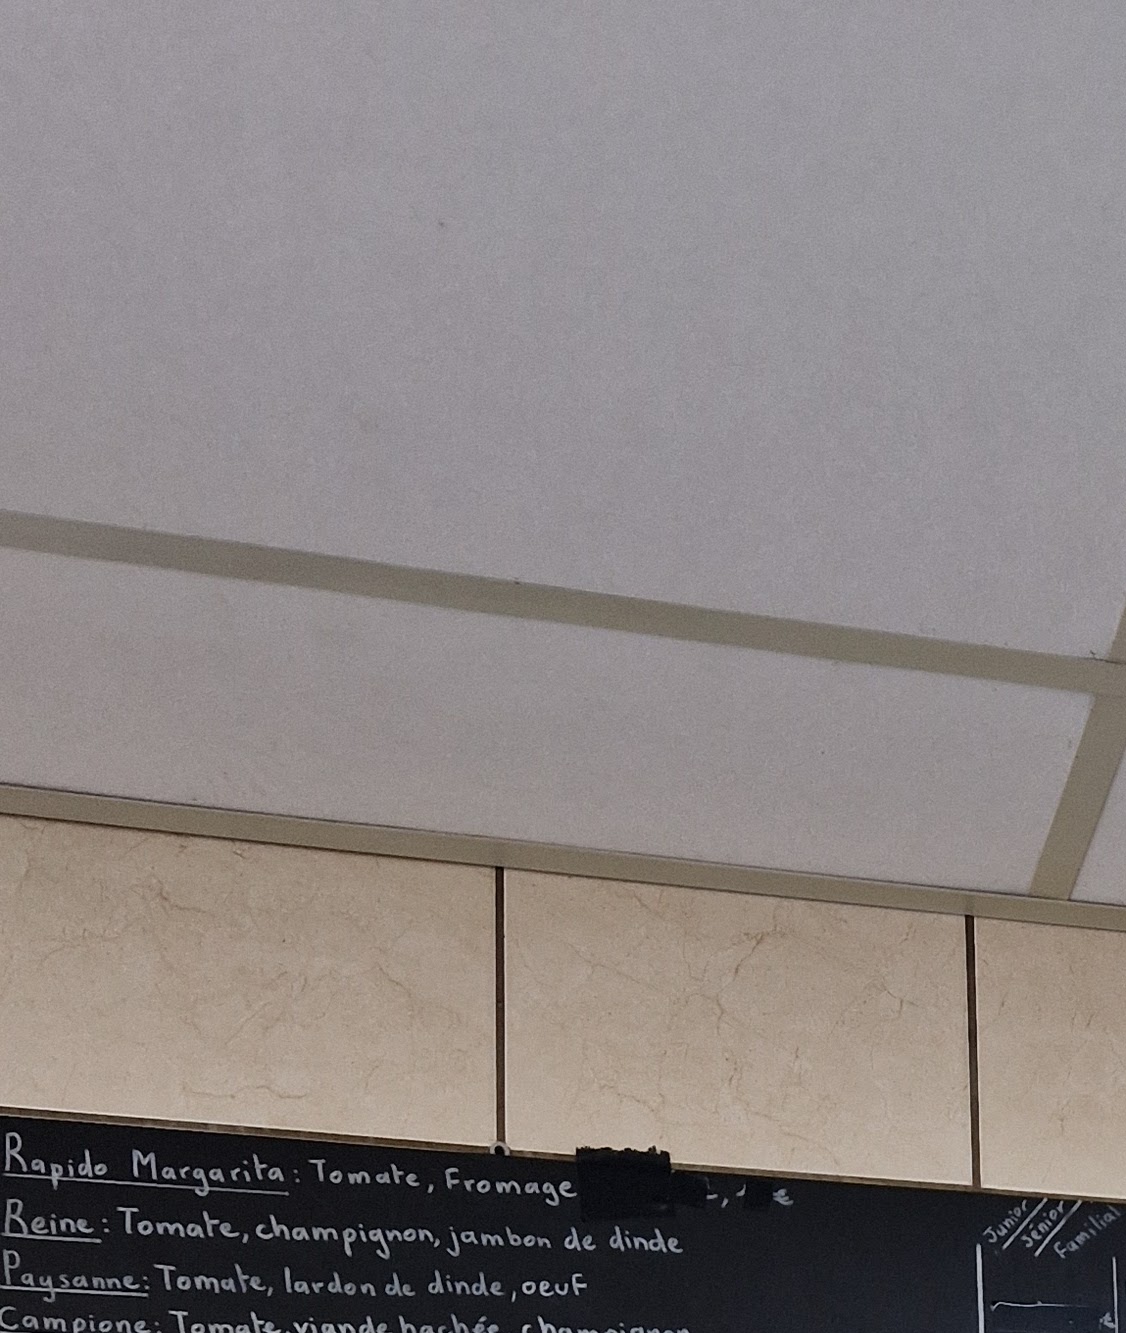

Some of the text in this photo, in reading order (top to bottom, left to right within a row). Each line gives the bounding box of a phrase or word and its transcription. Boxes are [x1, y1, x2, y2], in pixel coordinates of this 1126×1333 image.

[5, 1133, 109, 1193] Rapido
[446, 1224, 552, 1254] jambon
[564, 1228, 596, 1251] de
[609, 1228, 684, 1254] dinde
[284, 1269, 376, 1297] lardon
[384, 1270, 416, 1297] de
